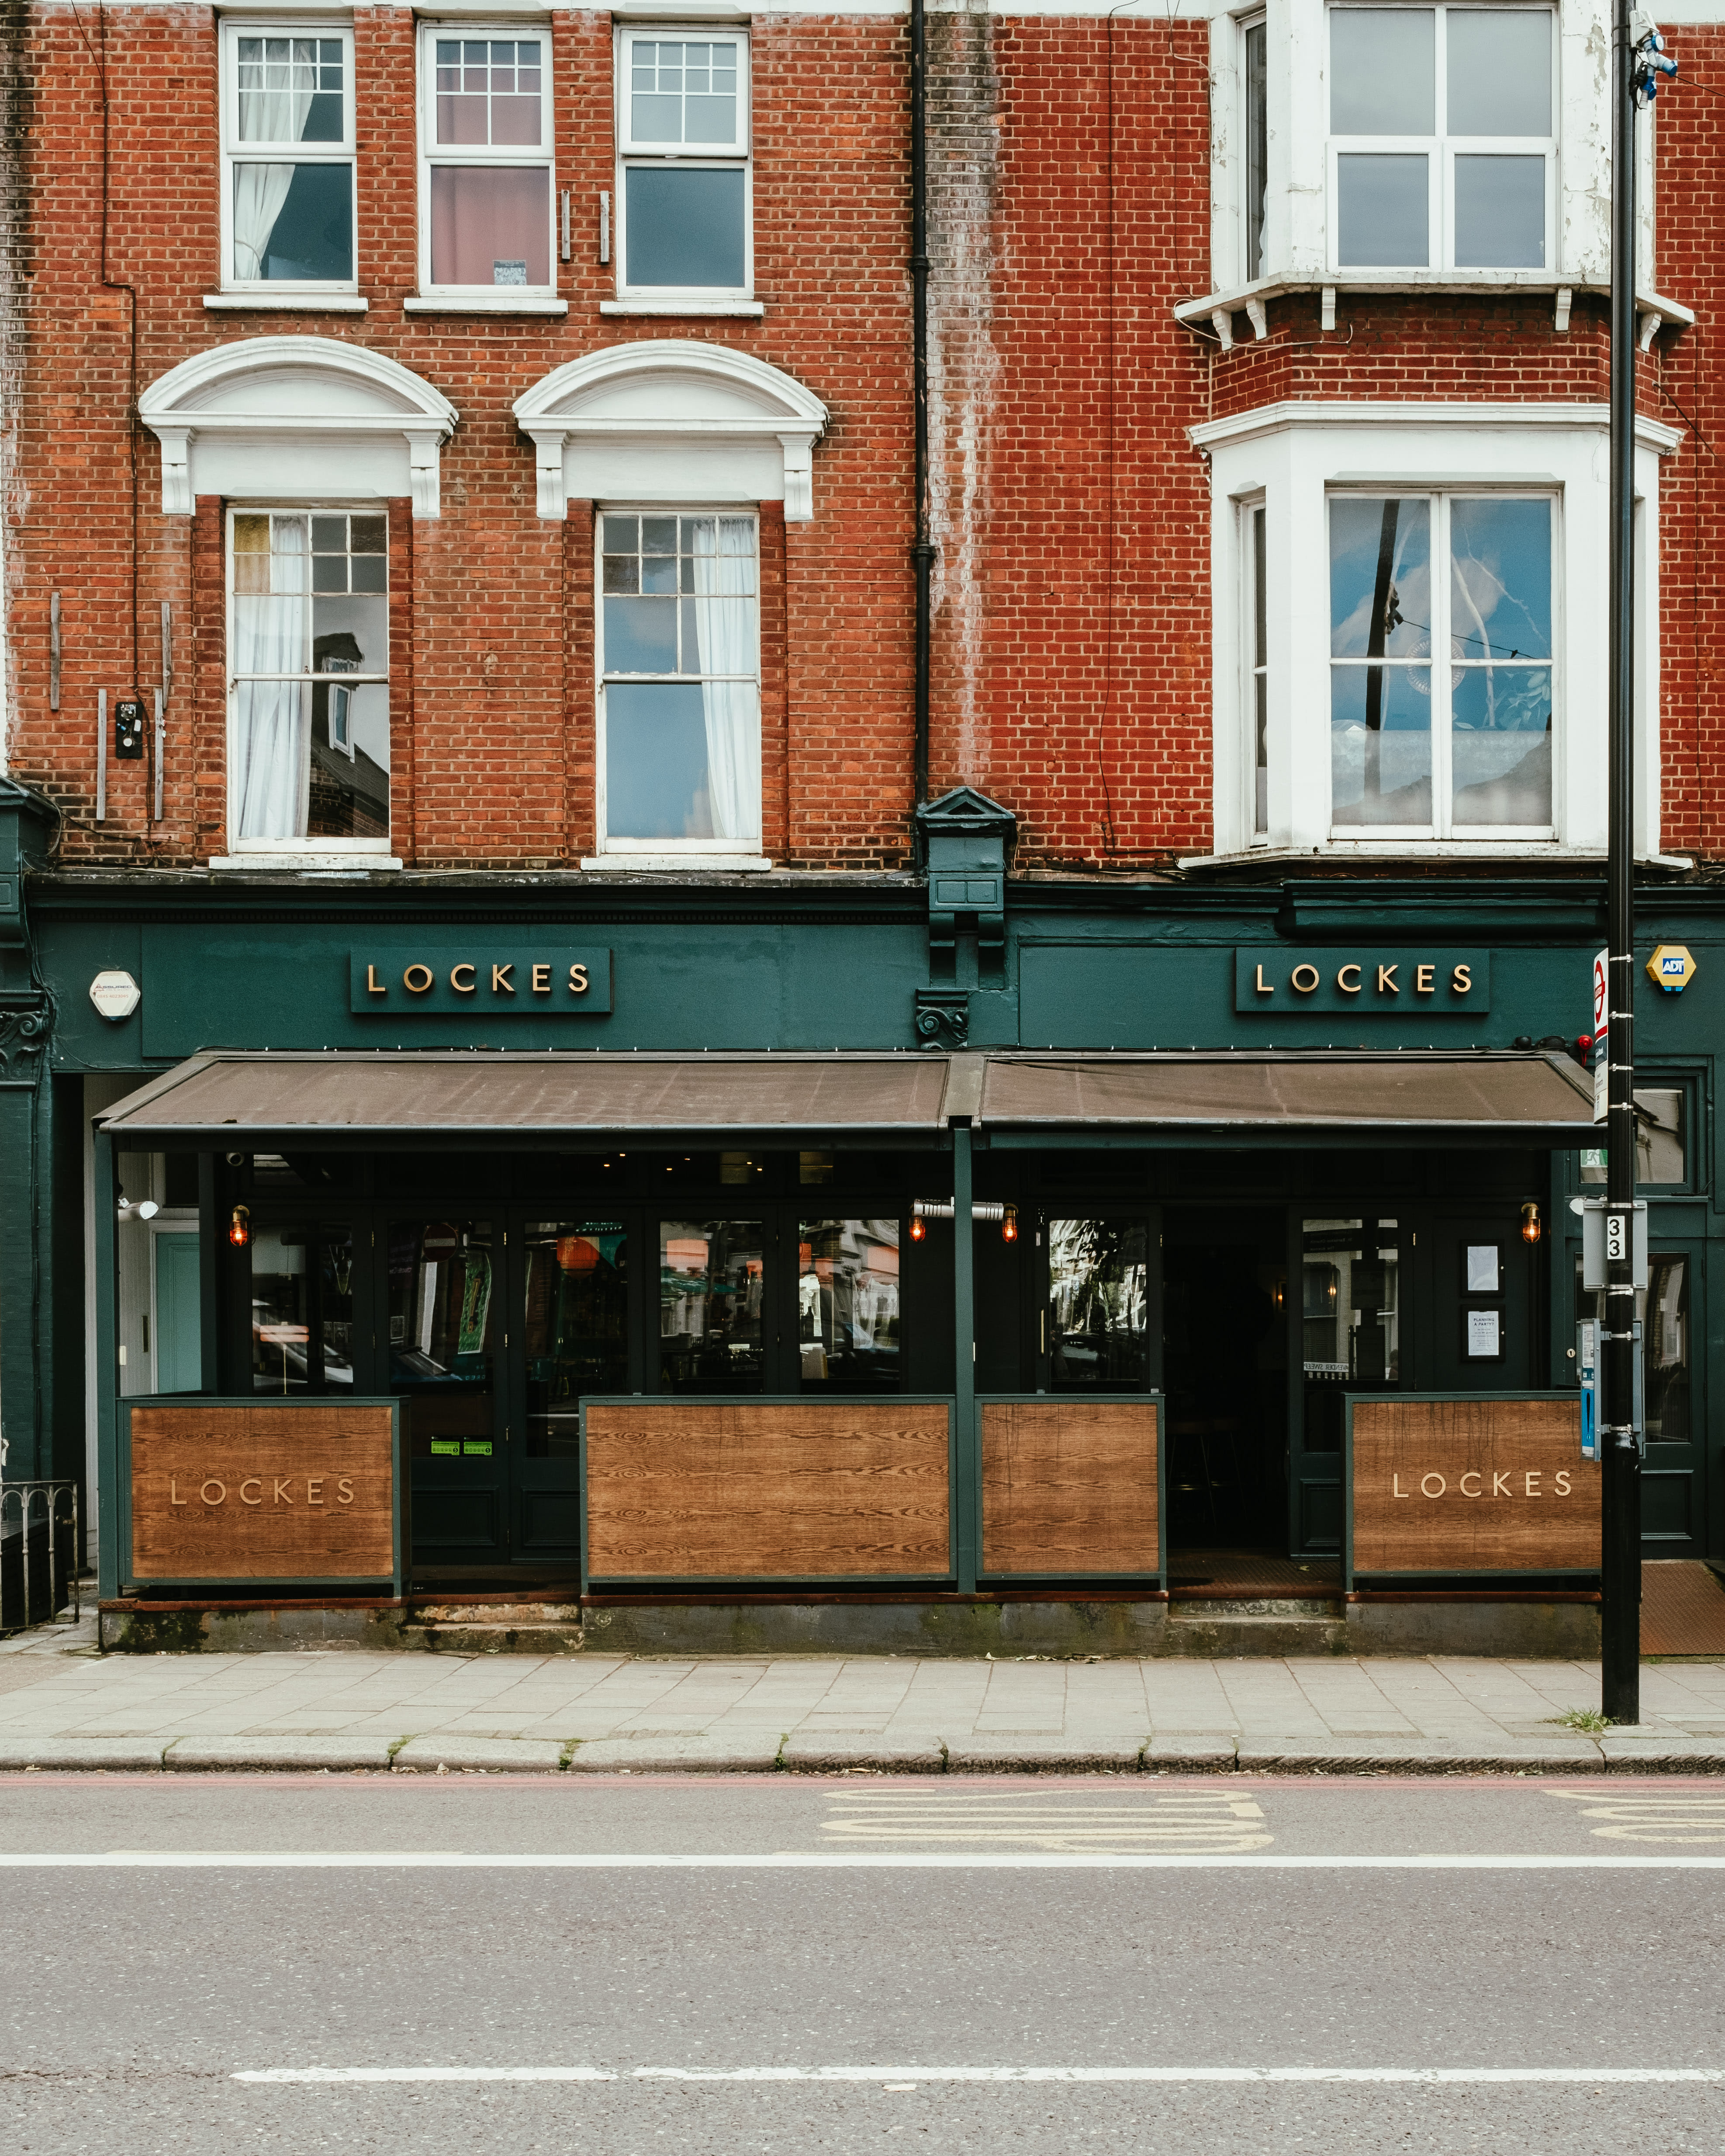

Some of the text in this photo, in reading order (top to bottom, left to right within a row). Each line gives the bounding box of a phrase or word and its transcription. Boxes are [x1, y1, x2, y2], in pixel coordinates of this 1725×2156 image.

[368, 964, 588, 992] LOCKES
[1257, 964, 1472, 992] LOCKES
[1663, 960, 1684, 972] ADT
[171, 1479, 354, 1506] LOCKES
[1393, 1471, 1572, 1499] LOCKES
